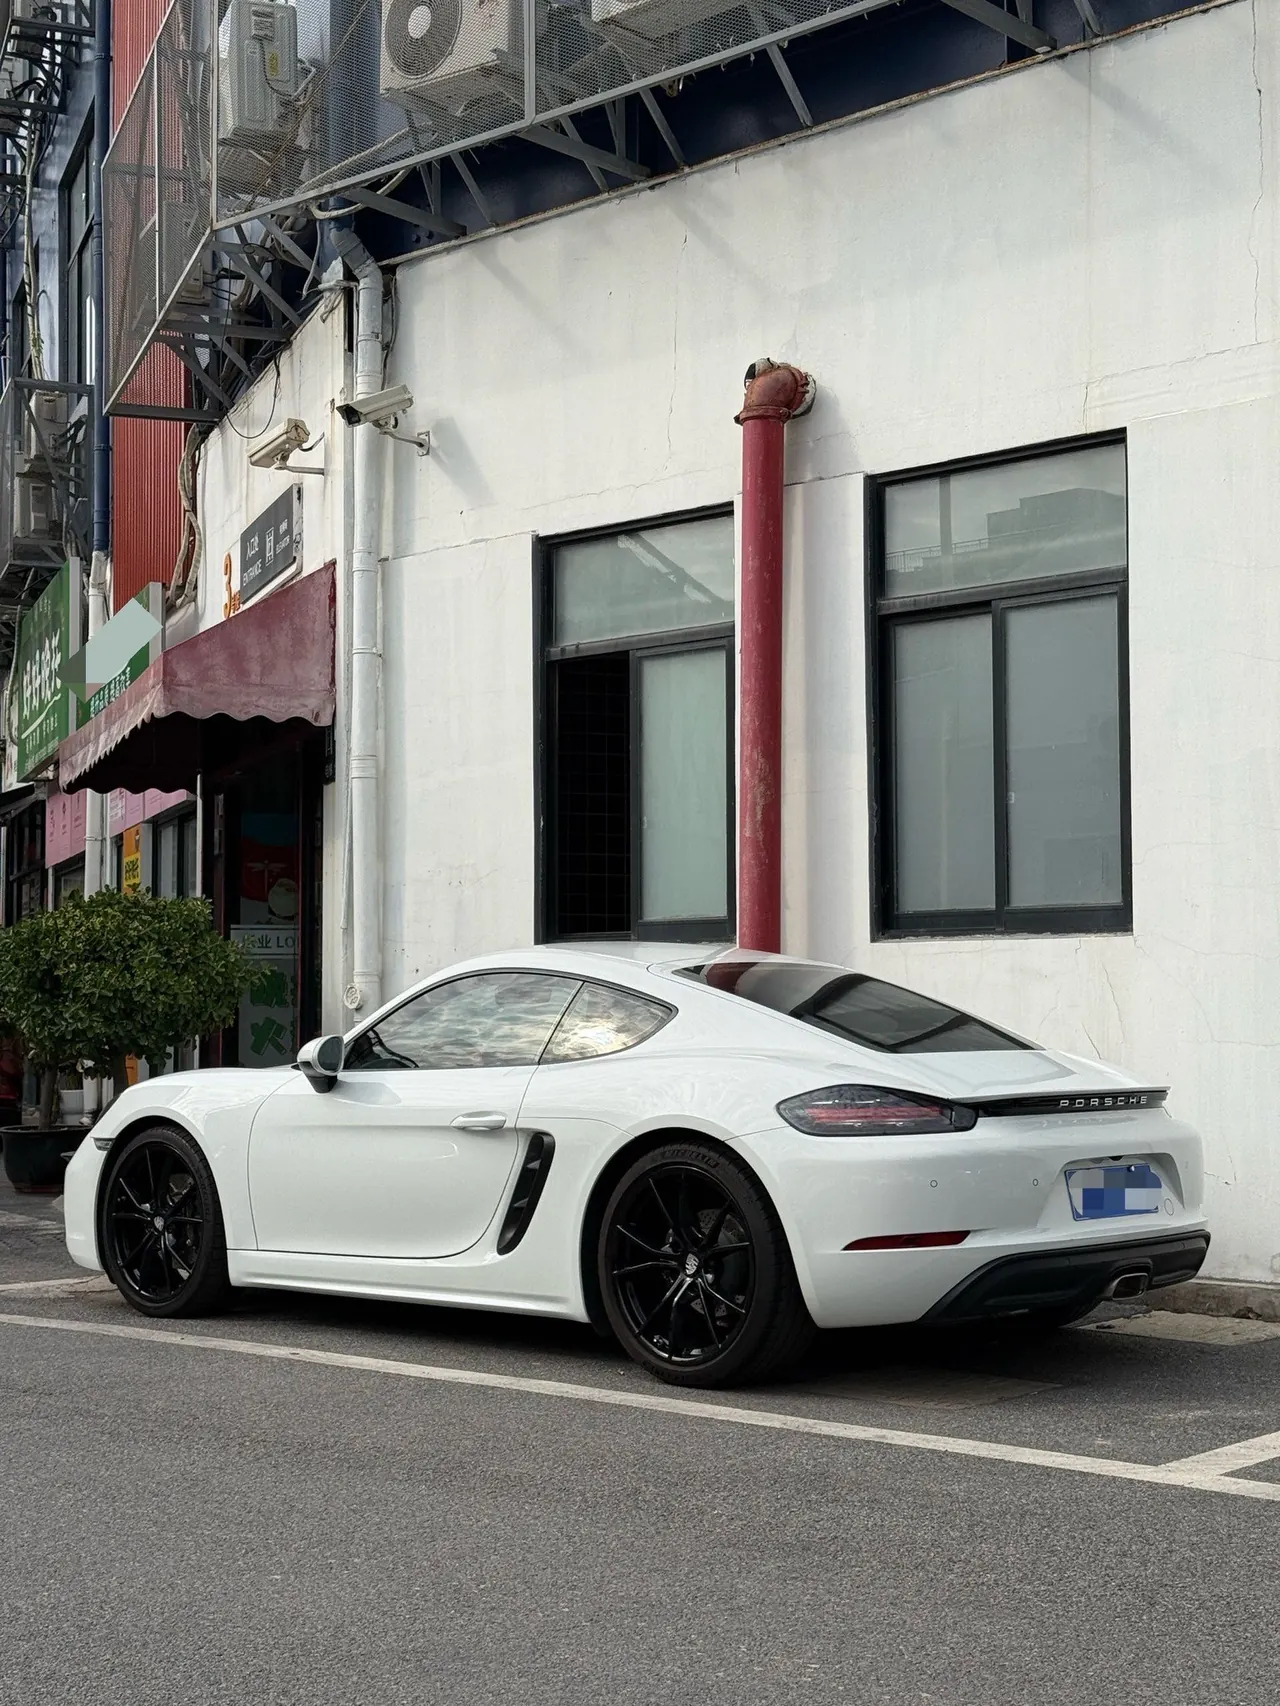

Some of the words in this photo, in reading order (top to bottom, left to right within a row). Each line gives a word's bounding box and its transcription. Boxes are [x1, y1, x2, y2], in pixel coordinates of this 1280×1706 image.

[223, 552, 232, 619] 3
[242, 558, 262, 587] ENTRANCE
[1059, 1096, 1148, 1108] PORSCHE
